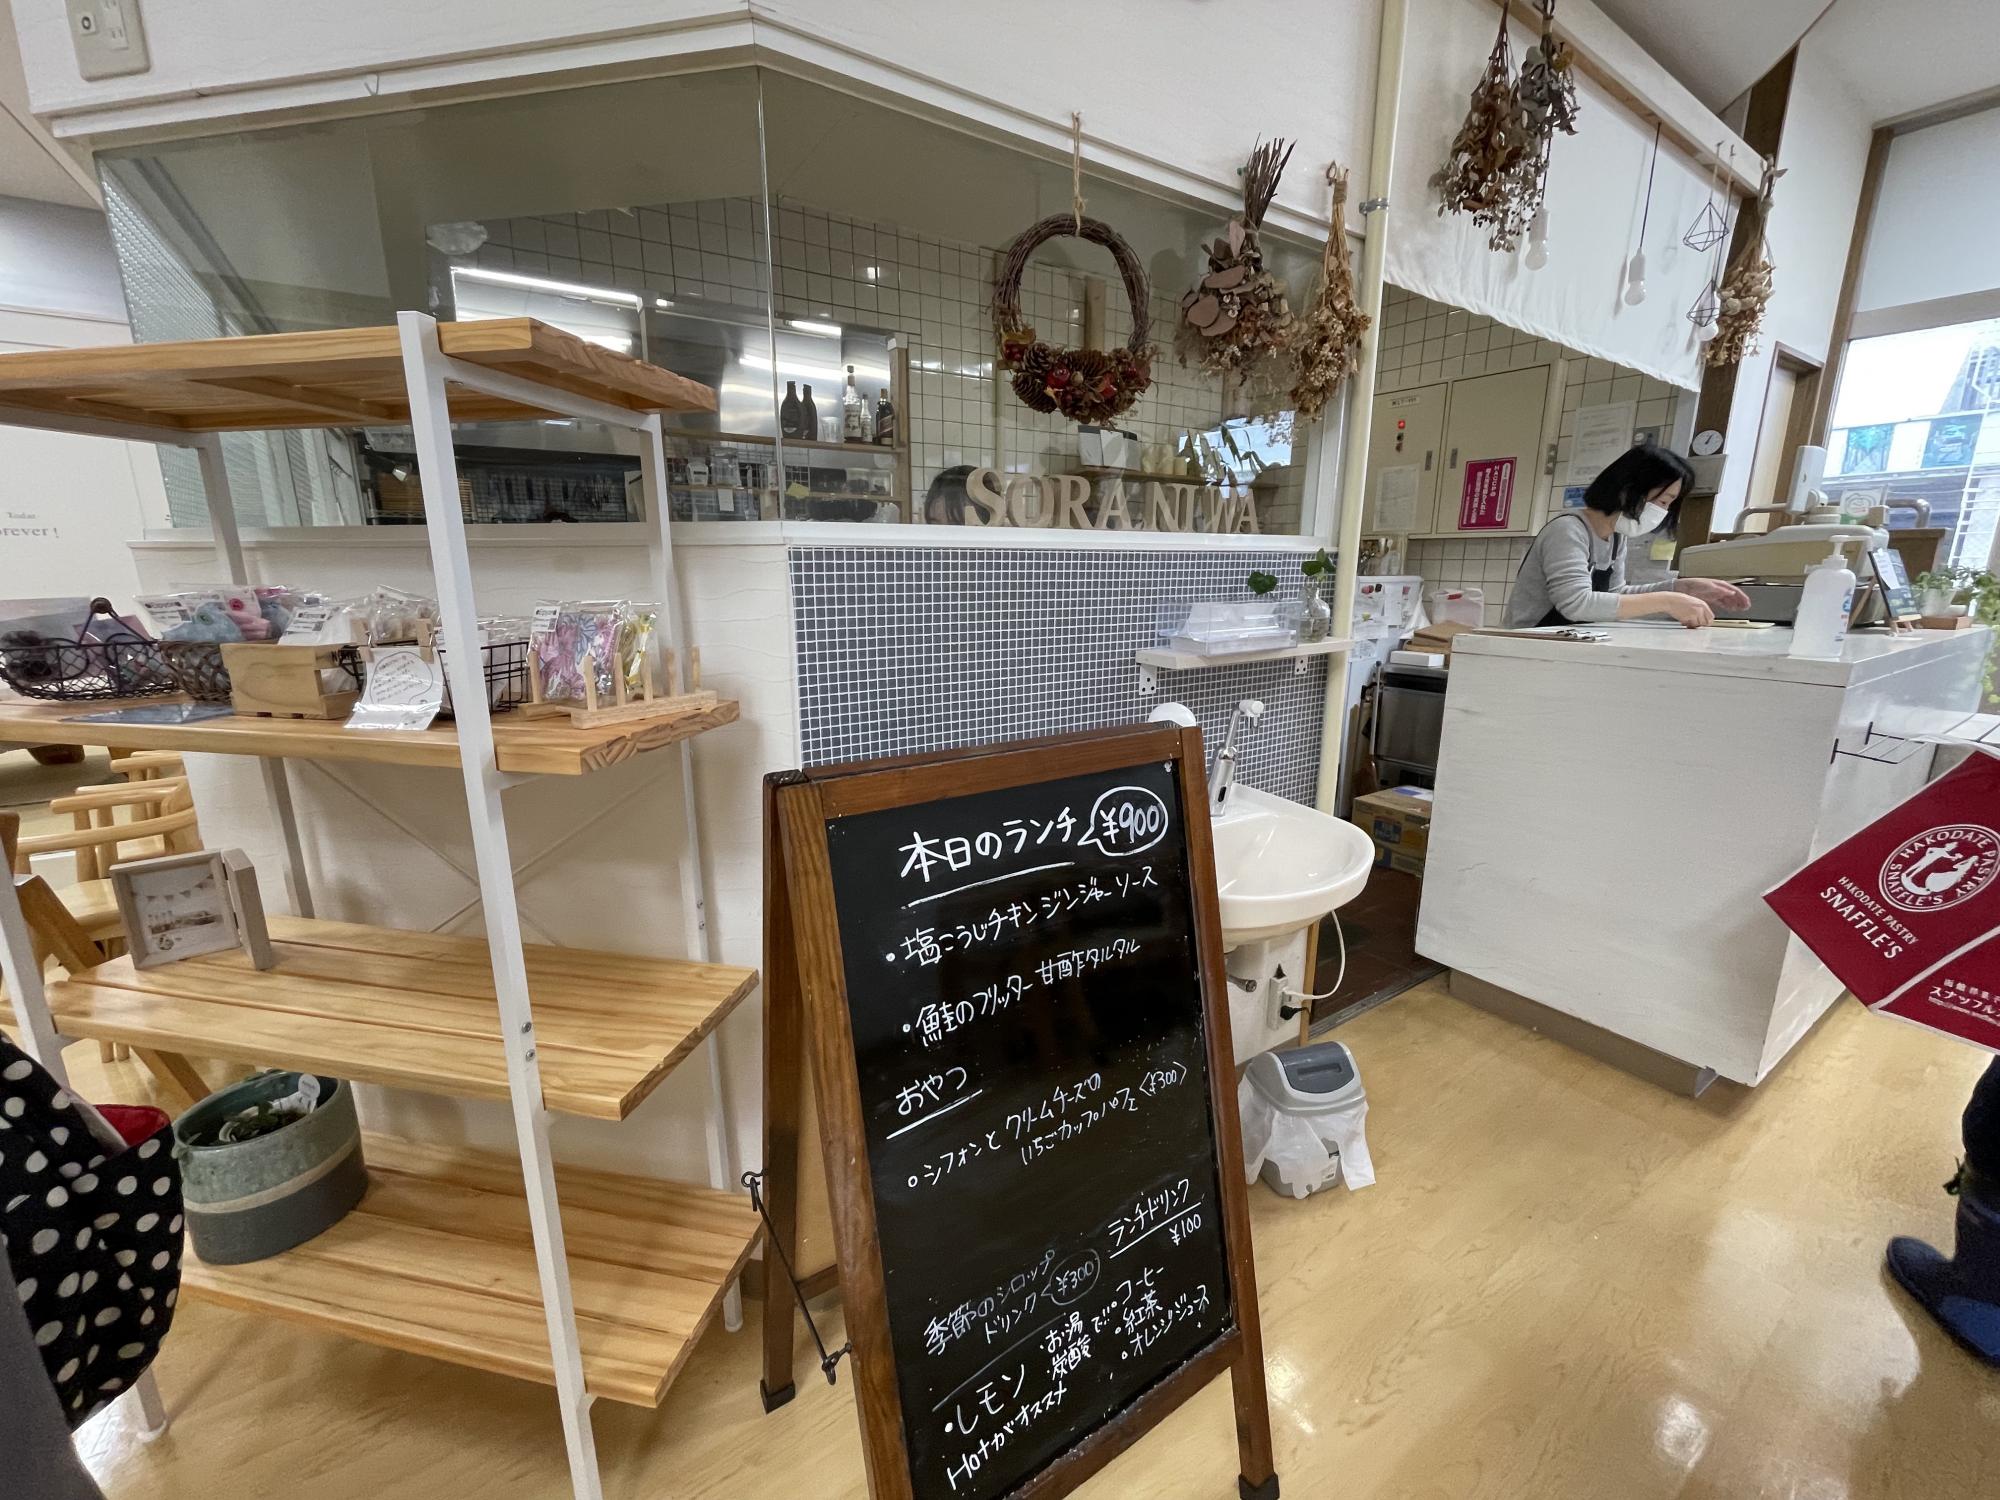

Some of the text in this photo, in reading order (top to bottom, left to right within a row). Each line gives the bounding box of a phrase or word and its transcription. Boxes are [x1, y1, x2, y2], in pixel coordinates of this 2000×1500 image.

[899, 806, 1077, 882] 本日のランチ
[1100, 802, 1162, 844] ¥900
[1887, 863, 1944, 906] SNAFFLE'S
[1900, 830, 1997, 898] HAKODATE PASTRY
[1820, 886, 1903, 960] SNAFFLE'S
[1838, 876, 1919, 946] HAKODATE PASTRY
[896, 1066, 967, 1115] おやつ
[1108, 1178, 1189, 1246] ランチドリンク
[1169, 1214, 1201, 1246] ¥100
[1055, 1261, 1094, 1296] ¥300
[1116, 1267, 1165, 1305] コーヒー
[985, 1292, 1036, 1344] ドリンク
[1045, 1311, 1083, 1353] お湯
[1122, 1290, 1163, 1335] 紅茶
[1052, 1334, 1091, 1380] 炭酸
[957, 1364, 1024, 1434] レモン
